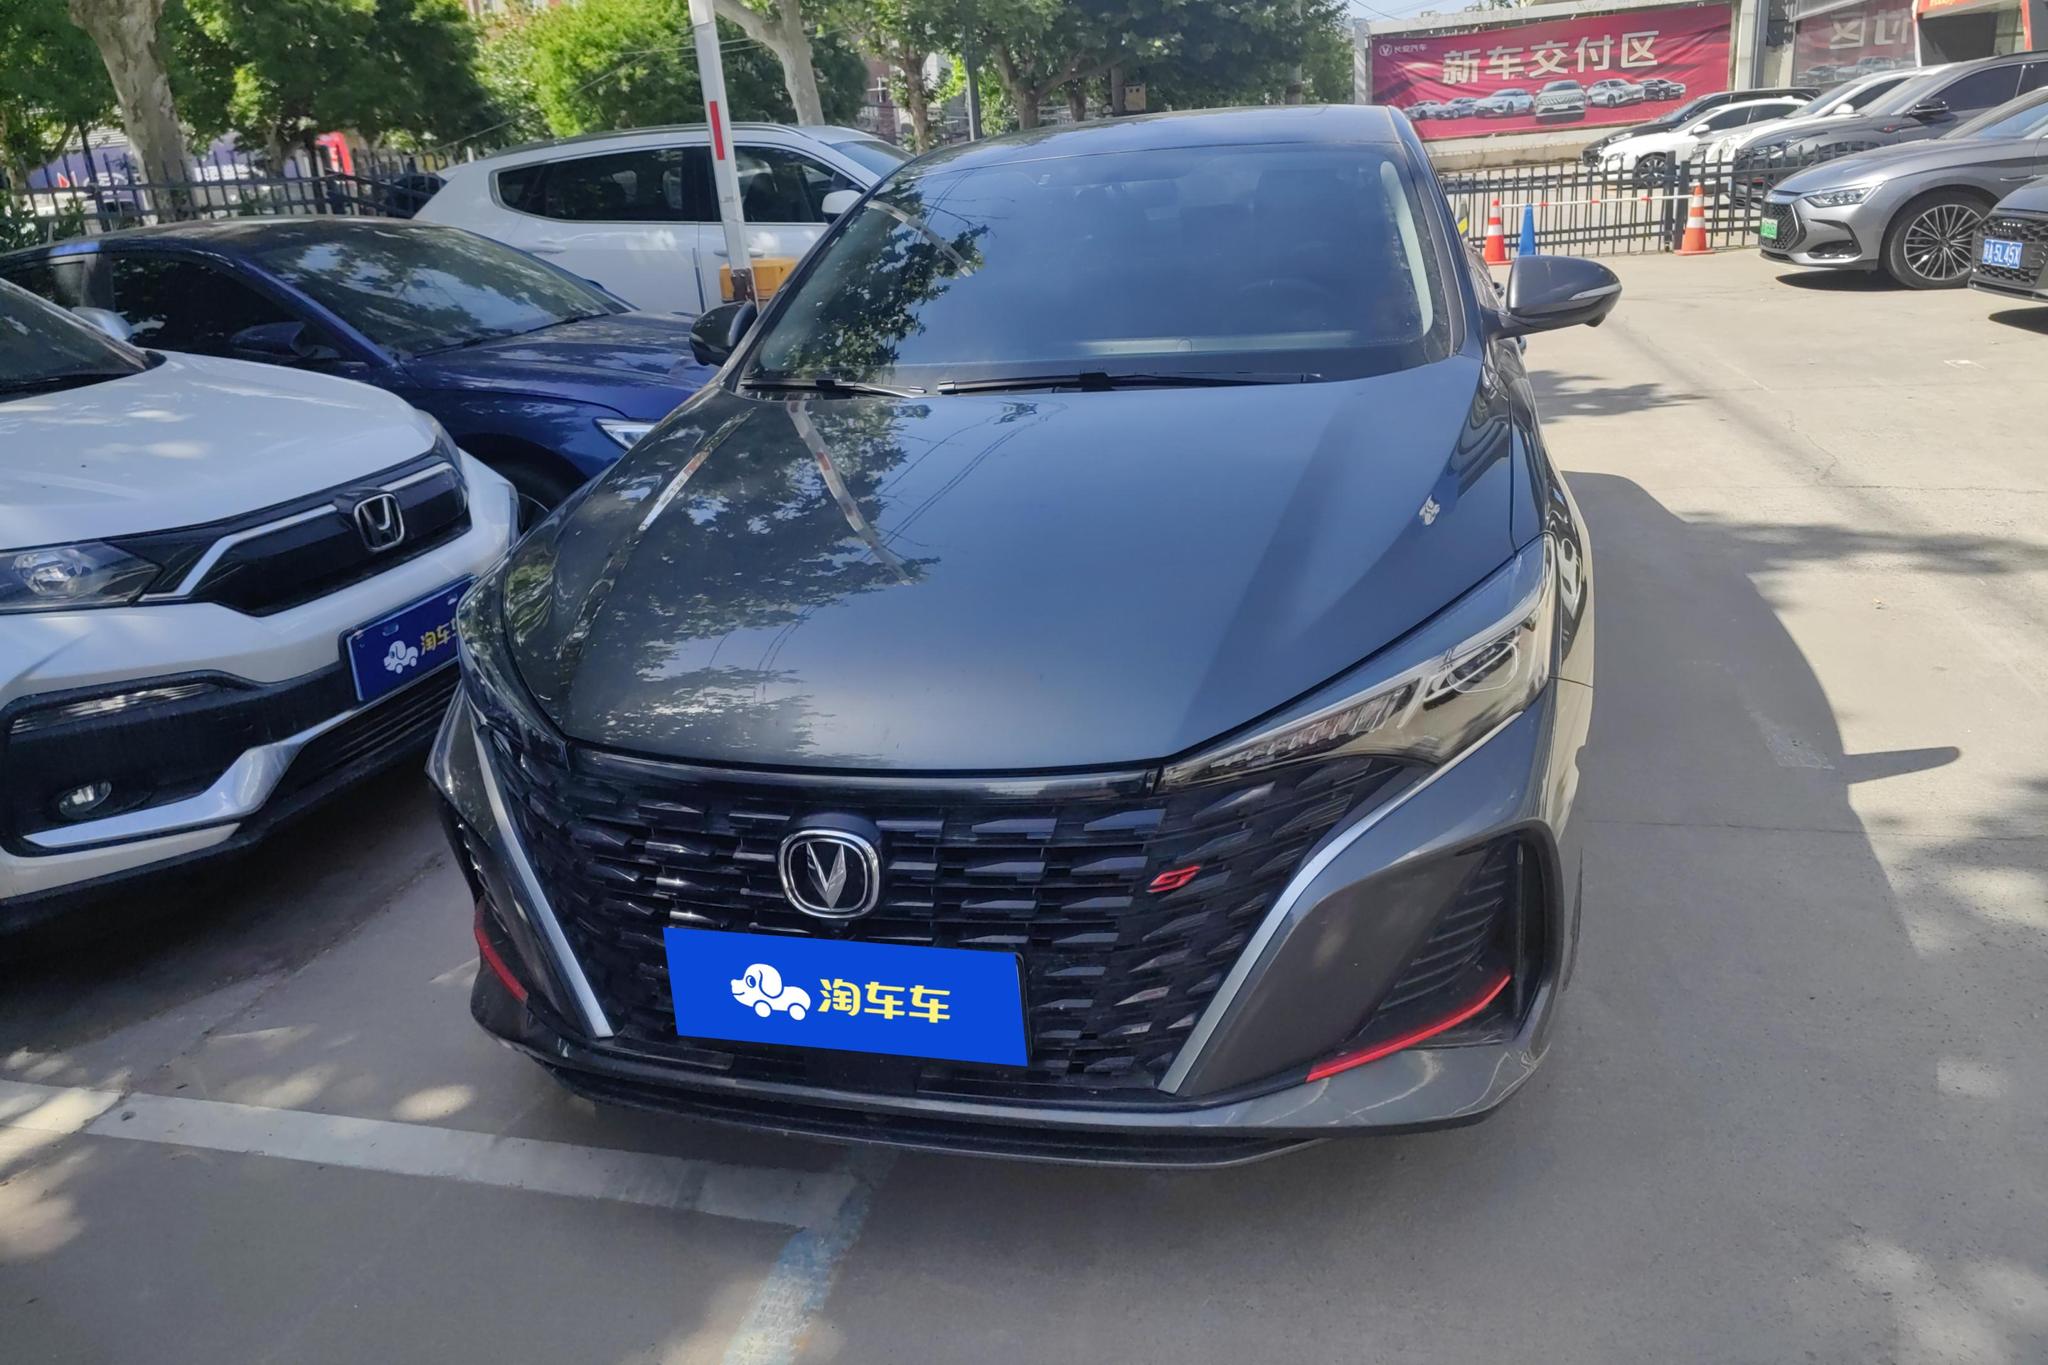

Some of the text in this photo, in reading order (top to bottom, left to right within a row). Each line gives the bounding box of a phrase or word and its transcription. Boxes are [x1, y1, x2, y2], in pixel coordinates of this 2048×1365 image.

[1441, 30, 1660, 85] 新车交付区
